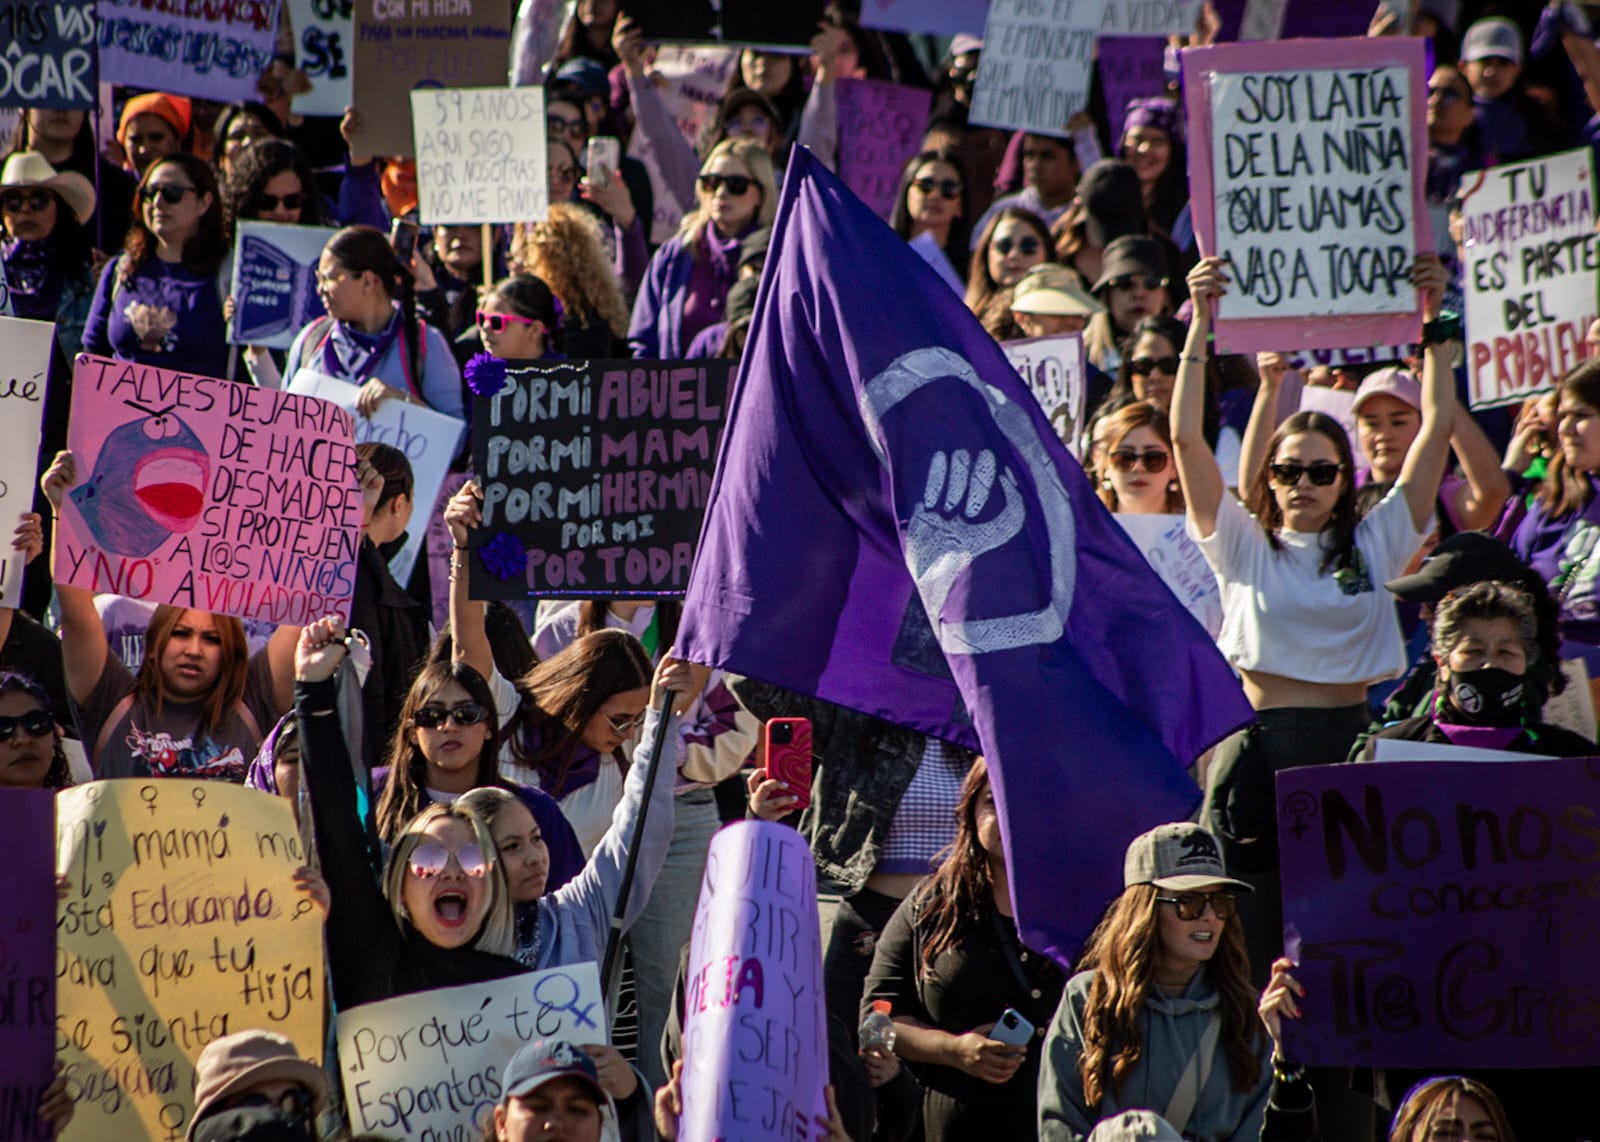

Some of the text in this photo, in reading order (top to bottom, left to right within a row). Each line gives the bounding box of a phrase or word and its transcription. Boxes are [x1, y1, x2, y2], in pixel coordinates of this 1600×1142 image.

[55, 3, 95, 44] VAS
[1127, 0, 1182, 33] VIDA
[435, 93, 462, 125] 59
[1236, 74, 1298, 124] SOY
[469, 130, 513, 160] SIGO
[1225, 122, 1408, 180] DE LA NIÑA
[421, 160, 537, 187] POR NOSOTRAS
[1500, 164, 1546, 203] TU
[430, 190, 453, 217] NO
[458, 187, 488, 217] ME
[1227, 178, 1405, 235] QUE JAMÁS
[1225, 244, 1411, 307] VAS A TOCAR
[1473, 252, 1507, 292] ES
[1503, 290, 1556, 331] DEL
[491, 374, 550, 427] POR
[219, 424, 359, 483] DE HACER
[487, 434, 550, 479] POR
[601, 426, 724, 467] MAM
[212, 466, 362, 528] DESMADRE
[482, 480, 555, 527] POR
[168, 536, 194, 566] A
[202, 506, 360, 563] SI PROTEJEN
[561, 519, 606, 549] POR
[67, 544, 89, 584] Y
[169, 570, 196, 608] A
[526, 549, 587, 590] POR
[131, 812, 230, 869] mamá
[255, 829, 304, 862] me
[1321, 784, 1442, 882] No
[139, 944, 195, 997] que
[240, 963, 316, 1021] Hija
[505, 996, 561, 1042] te
[738, 1013, 801, 1086] SER
[355, 1065, 503, 1133] Espantas
